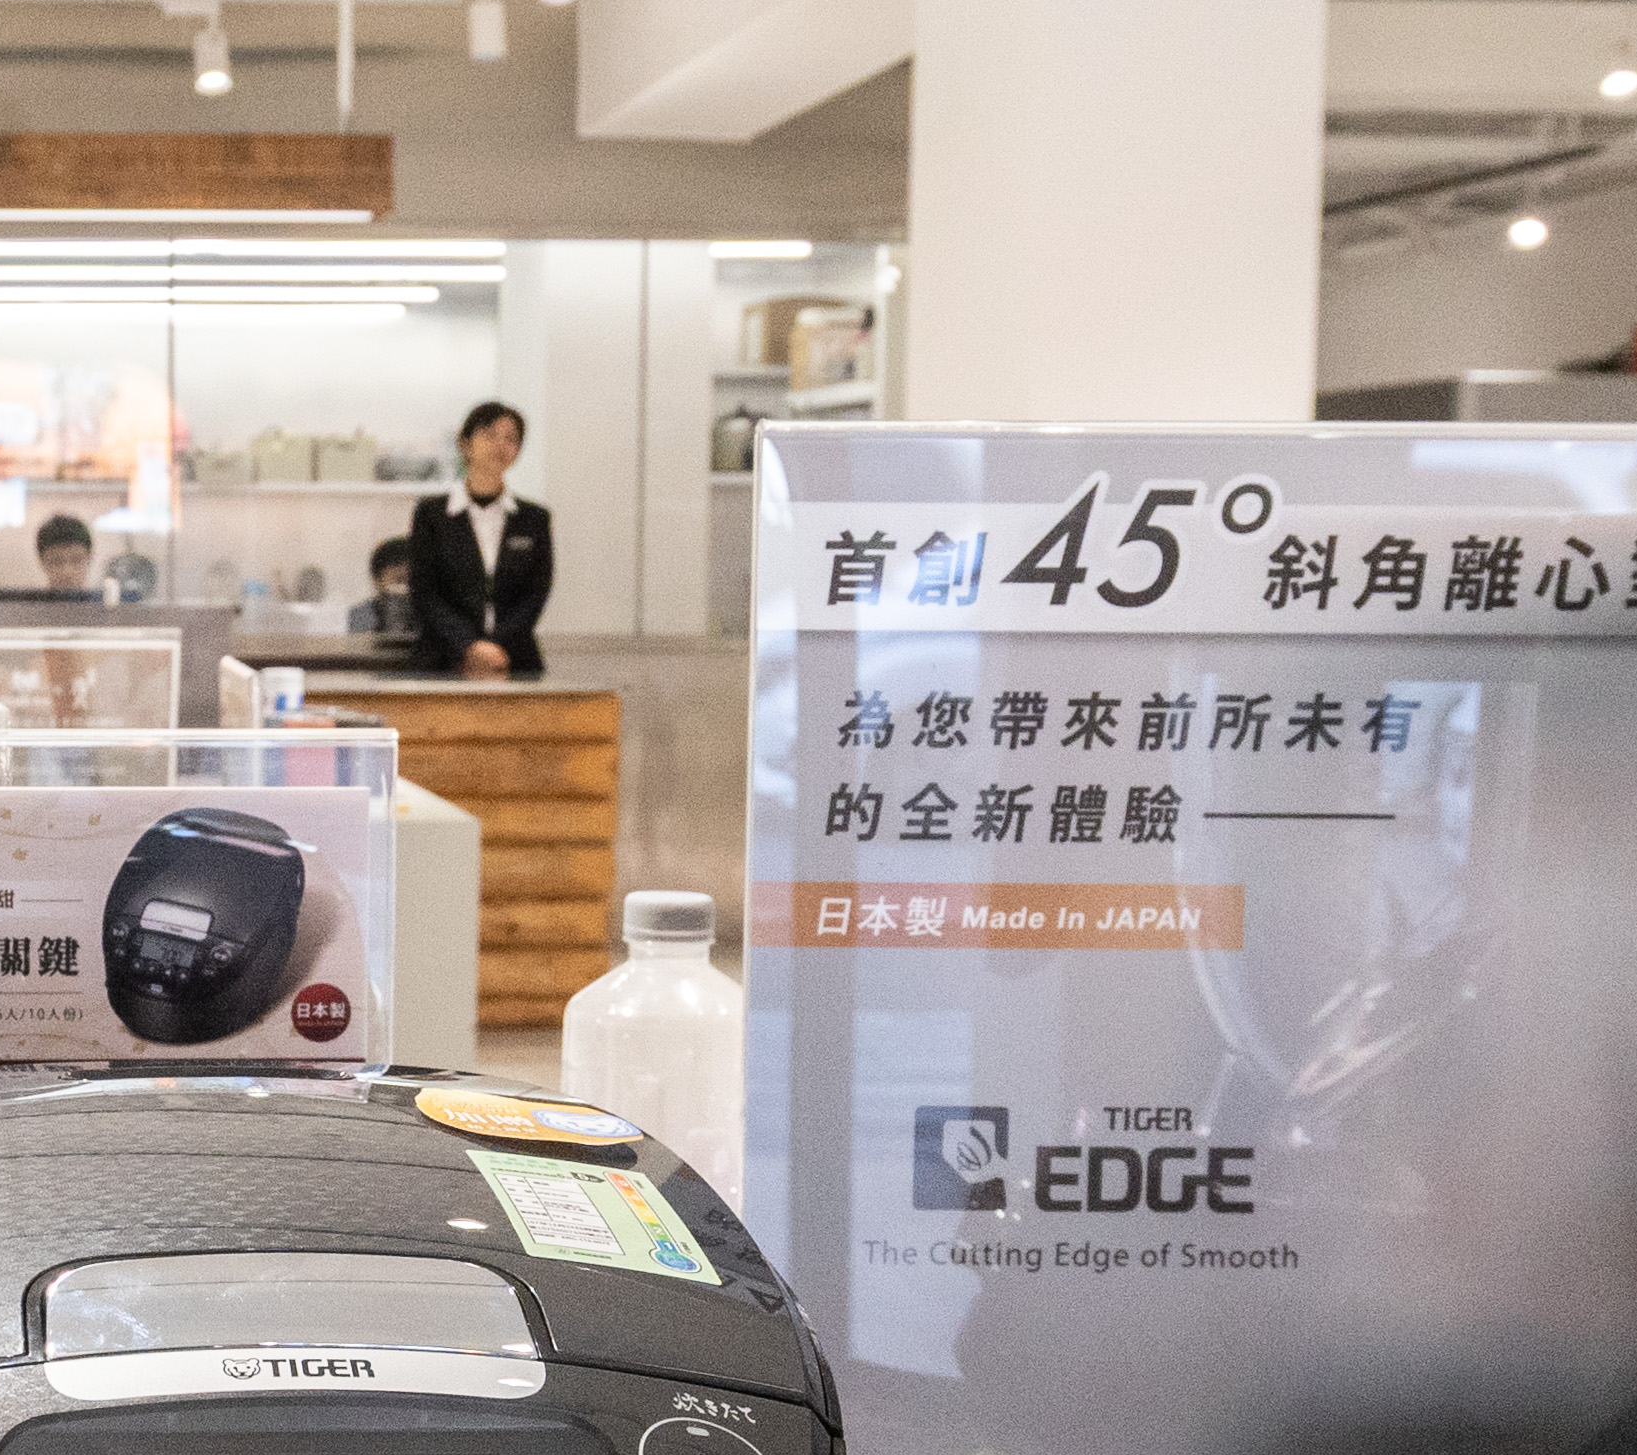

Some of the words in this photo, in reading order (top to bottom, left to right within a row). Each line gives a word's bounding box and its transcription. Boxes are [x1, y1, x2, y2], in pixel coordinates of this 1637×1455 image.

[836, 692, 1422, 752] 為您帶來前所未有
[824, 783, 1184, 844] 的全新體驗
[815, 897, 946, 938] 日本製
[961, 905, 1048, 931] Made
[1059, 905, 1085, 931] In
[1096, 906, 1201, 932] JAPAN
[1103, 1108, 1191, 1132] TIGER
[1033, 1148, 1254, 1213] EDGE
[864, 1240, 917, 1268] The
[928, 1240, 1043, 1275] Cutting
[1055, 1240, 1130, 1275] Edge
[1139, 1240, 1170, 1269] of
[1180, 1240, 1298, 1271] Smooth
[260, 1359, 374, 1380] TIGER
[673, 1392, 756, 1424] 炊きたて
